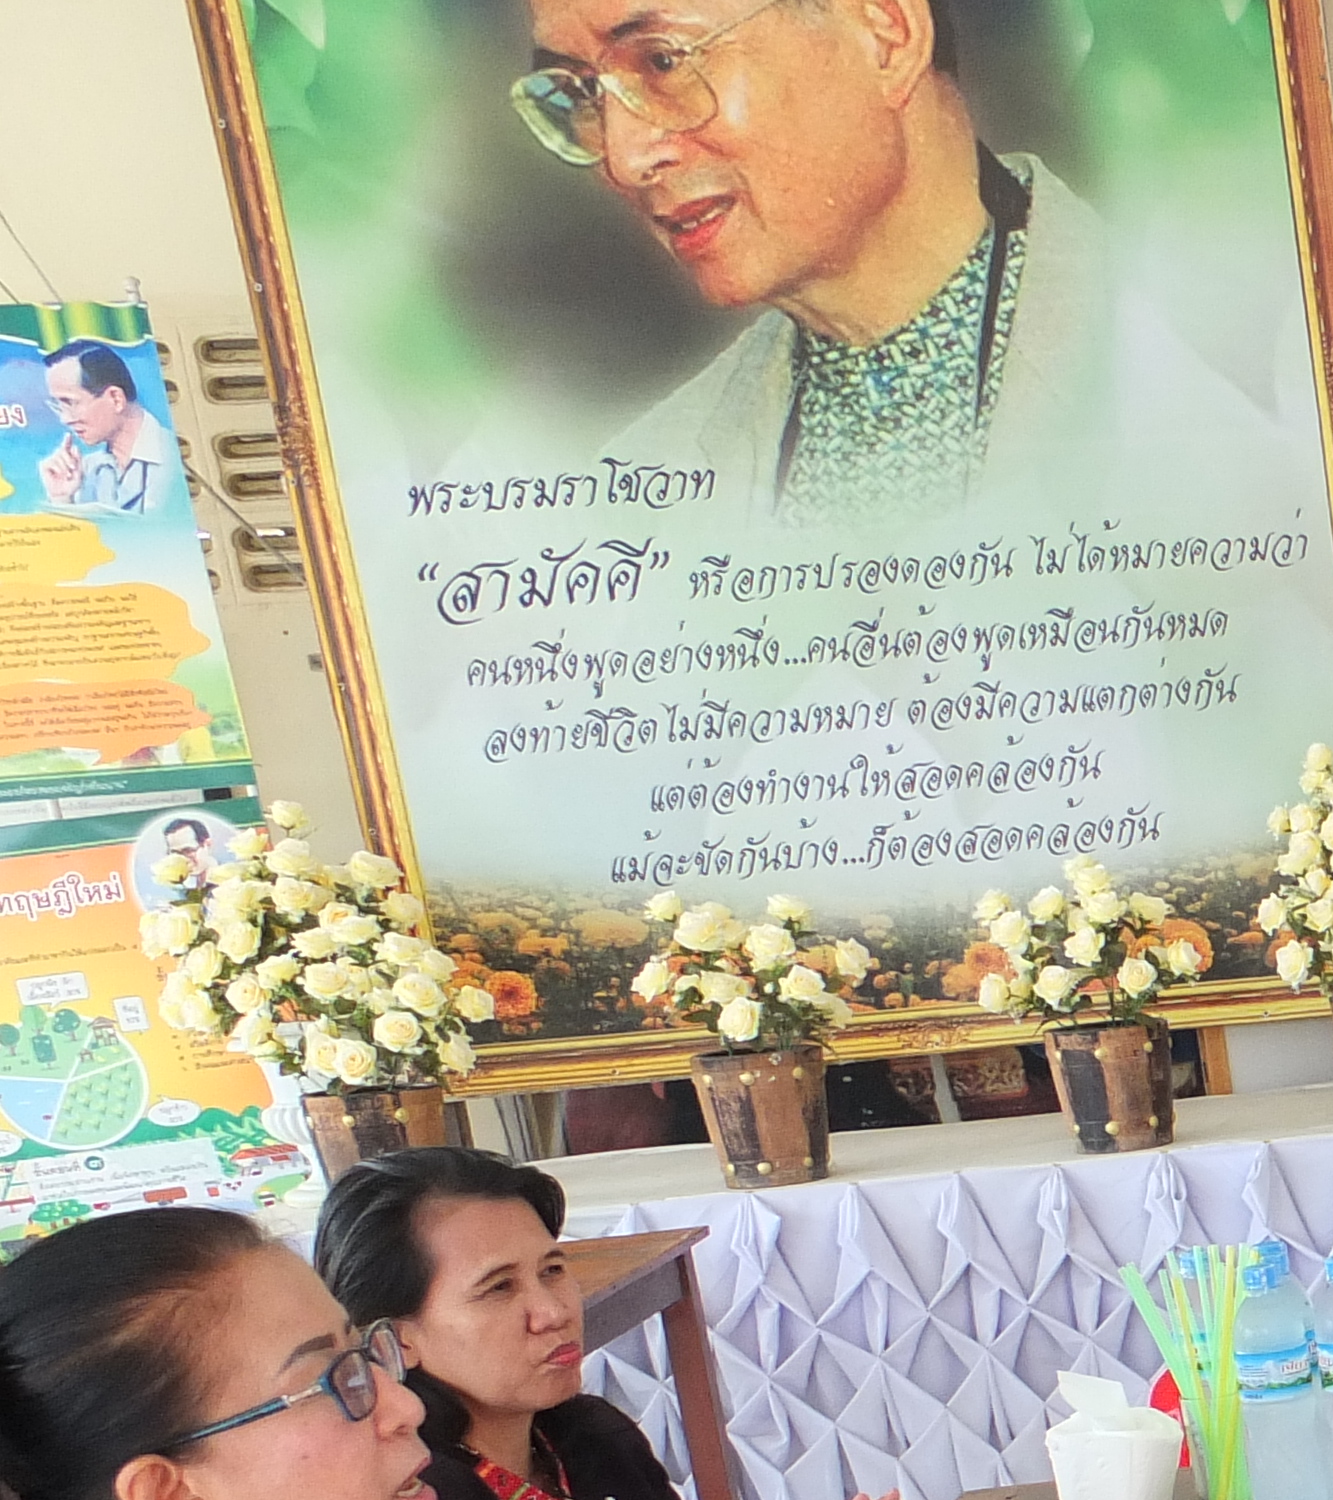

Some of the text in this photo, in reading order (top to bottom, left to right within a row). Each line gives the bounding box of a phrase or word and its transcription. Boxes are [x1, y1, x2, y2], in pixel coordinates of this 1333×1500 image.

[407, 457, 716, 517] พระบรมราโชวาท
[688, 535, 1018, 602] หรือการปรองดองกัน
[1028, 507, 1309, 574] ไม่ได้หมายความว่า
[906, 656, 1241, 731] ต้องมีความแตกต่างกัน
[650, 734, 1107, 815] แต่ต้องทำงานให้สอดคล้องกัน
